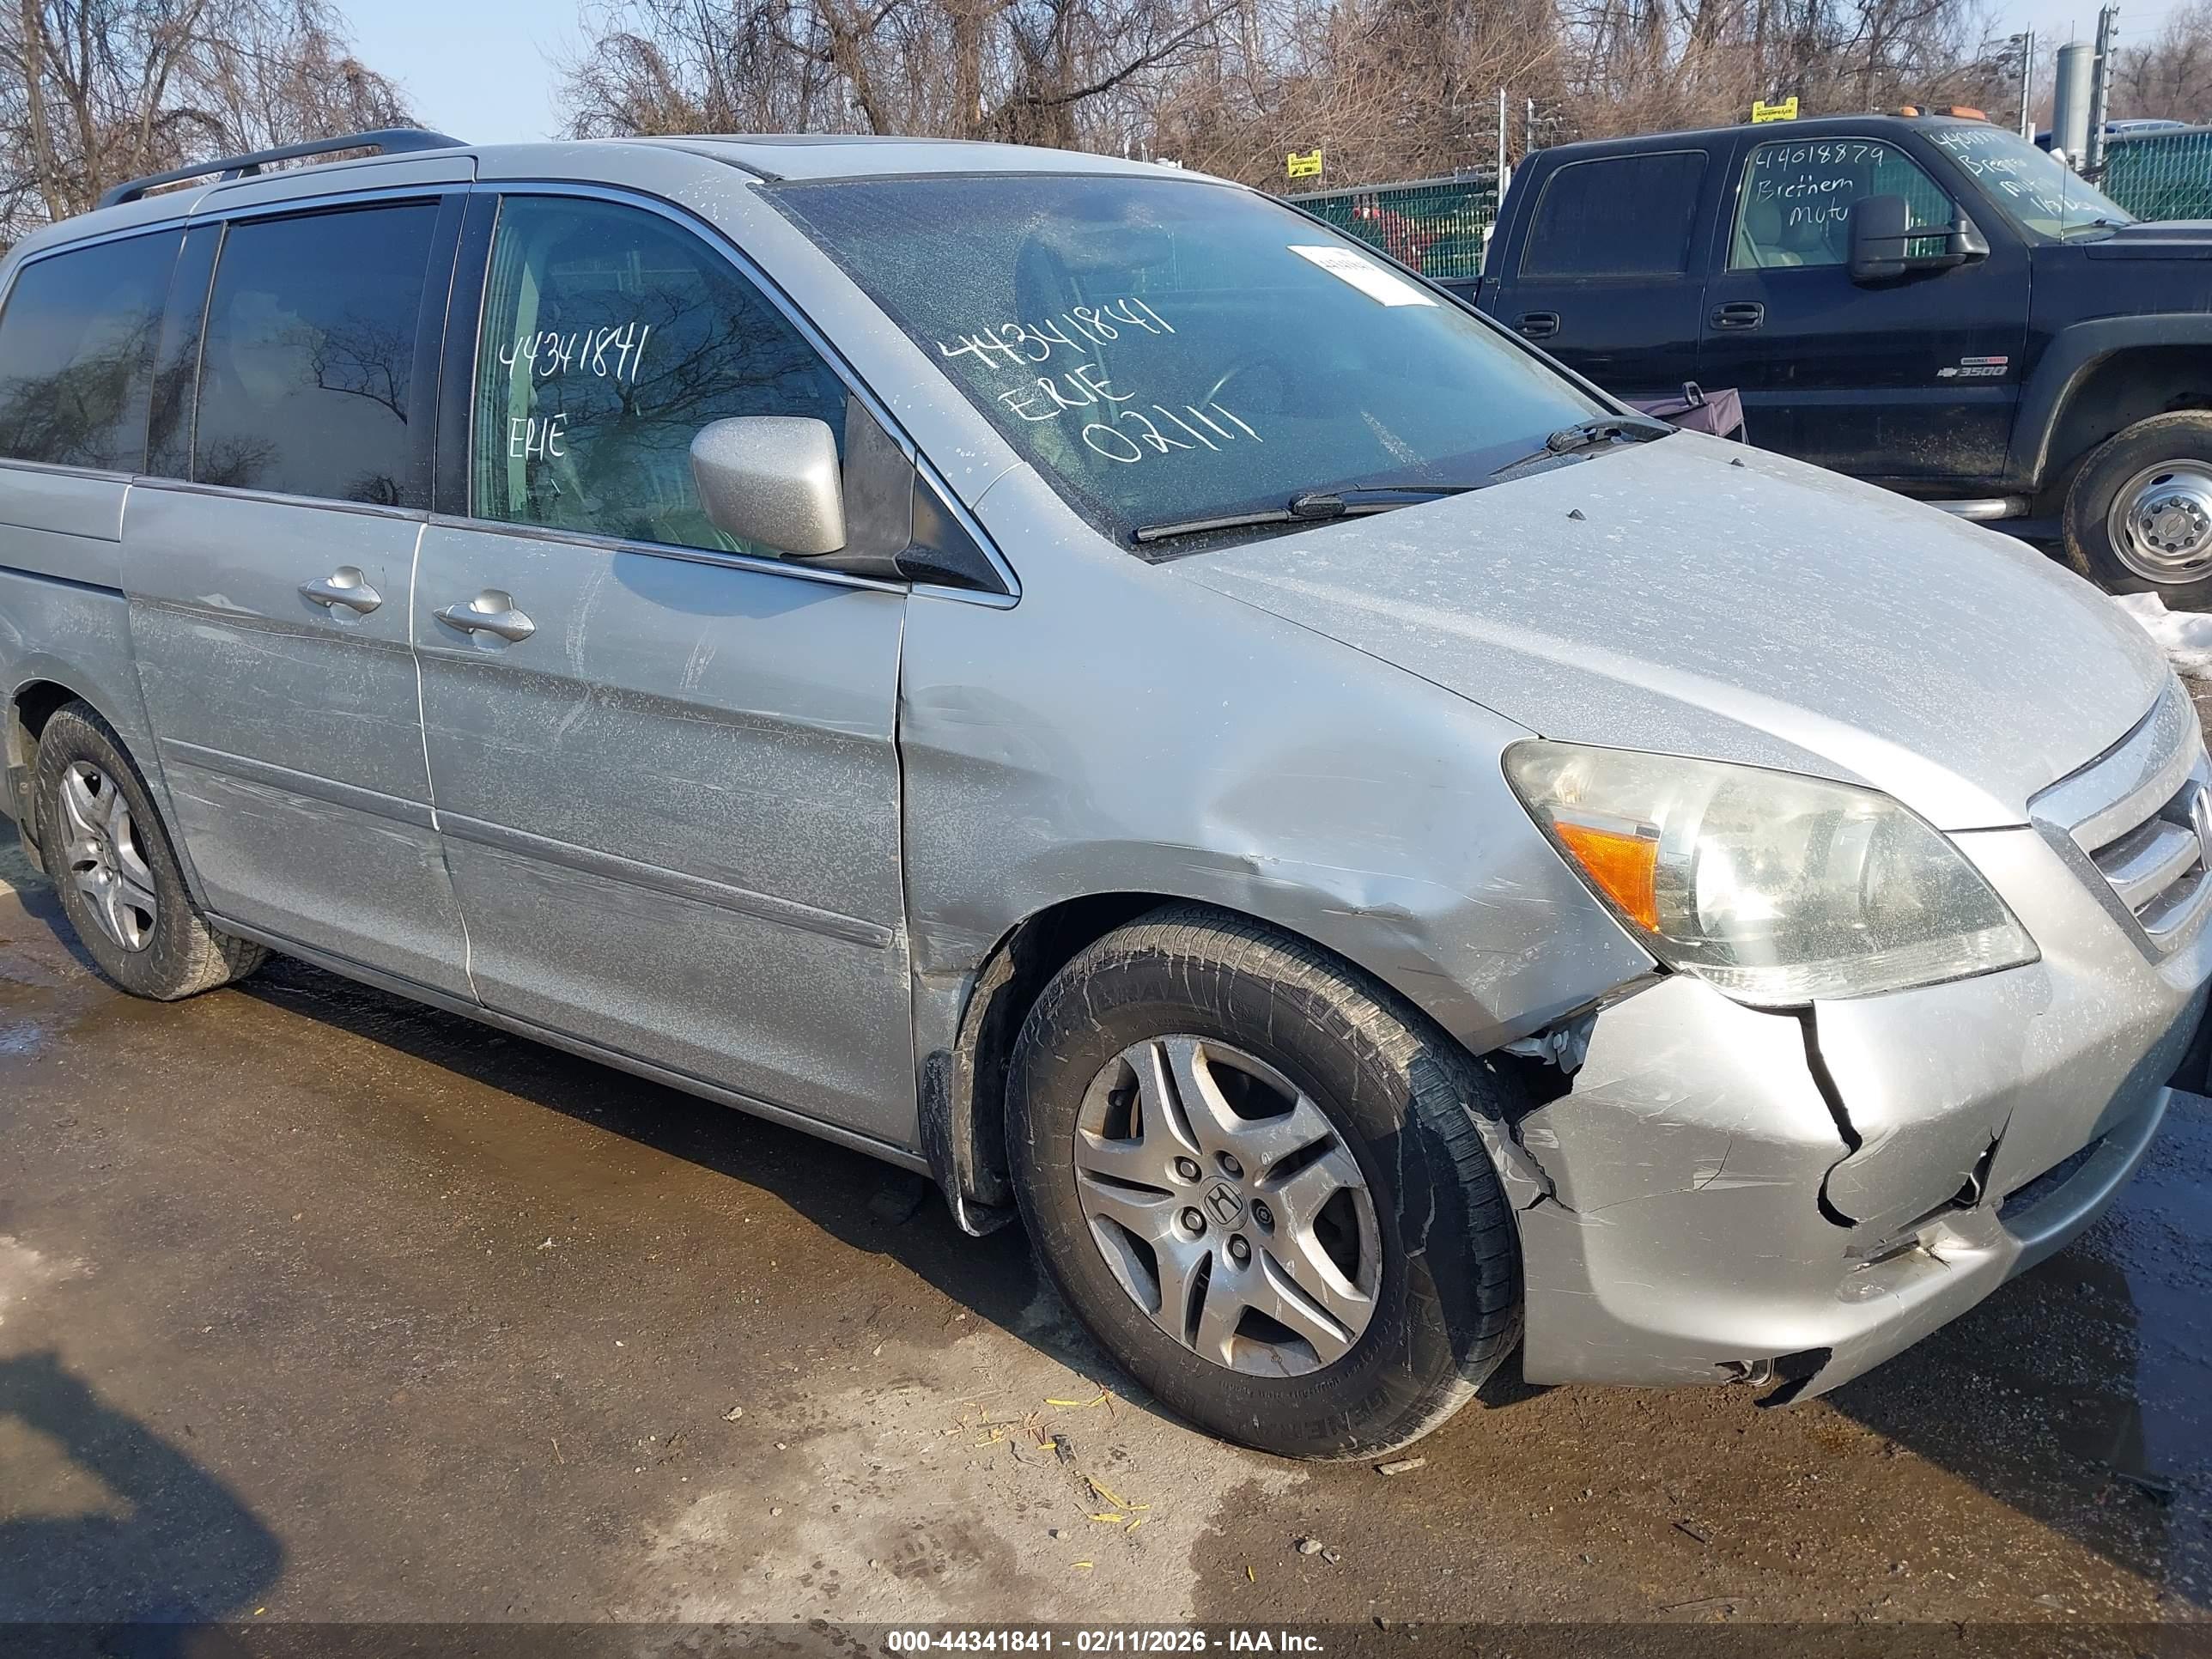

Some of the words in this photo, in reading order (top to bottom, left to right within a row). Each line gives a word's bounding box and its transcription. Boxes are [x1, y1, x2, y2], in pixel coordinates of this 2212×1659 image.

[1756, 143, 1883, 172] 44018879
[499, 321, 650, 384] 44341841
[937, 297, 1176, 368] 44341841
[998, 363, 1135, 421] ERIE
[1959, 366, 2008, 377] 3500
[509, 412, 568, 461] ERIE
